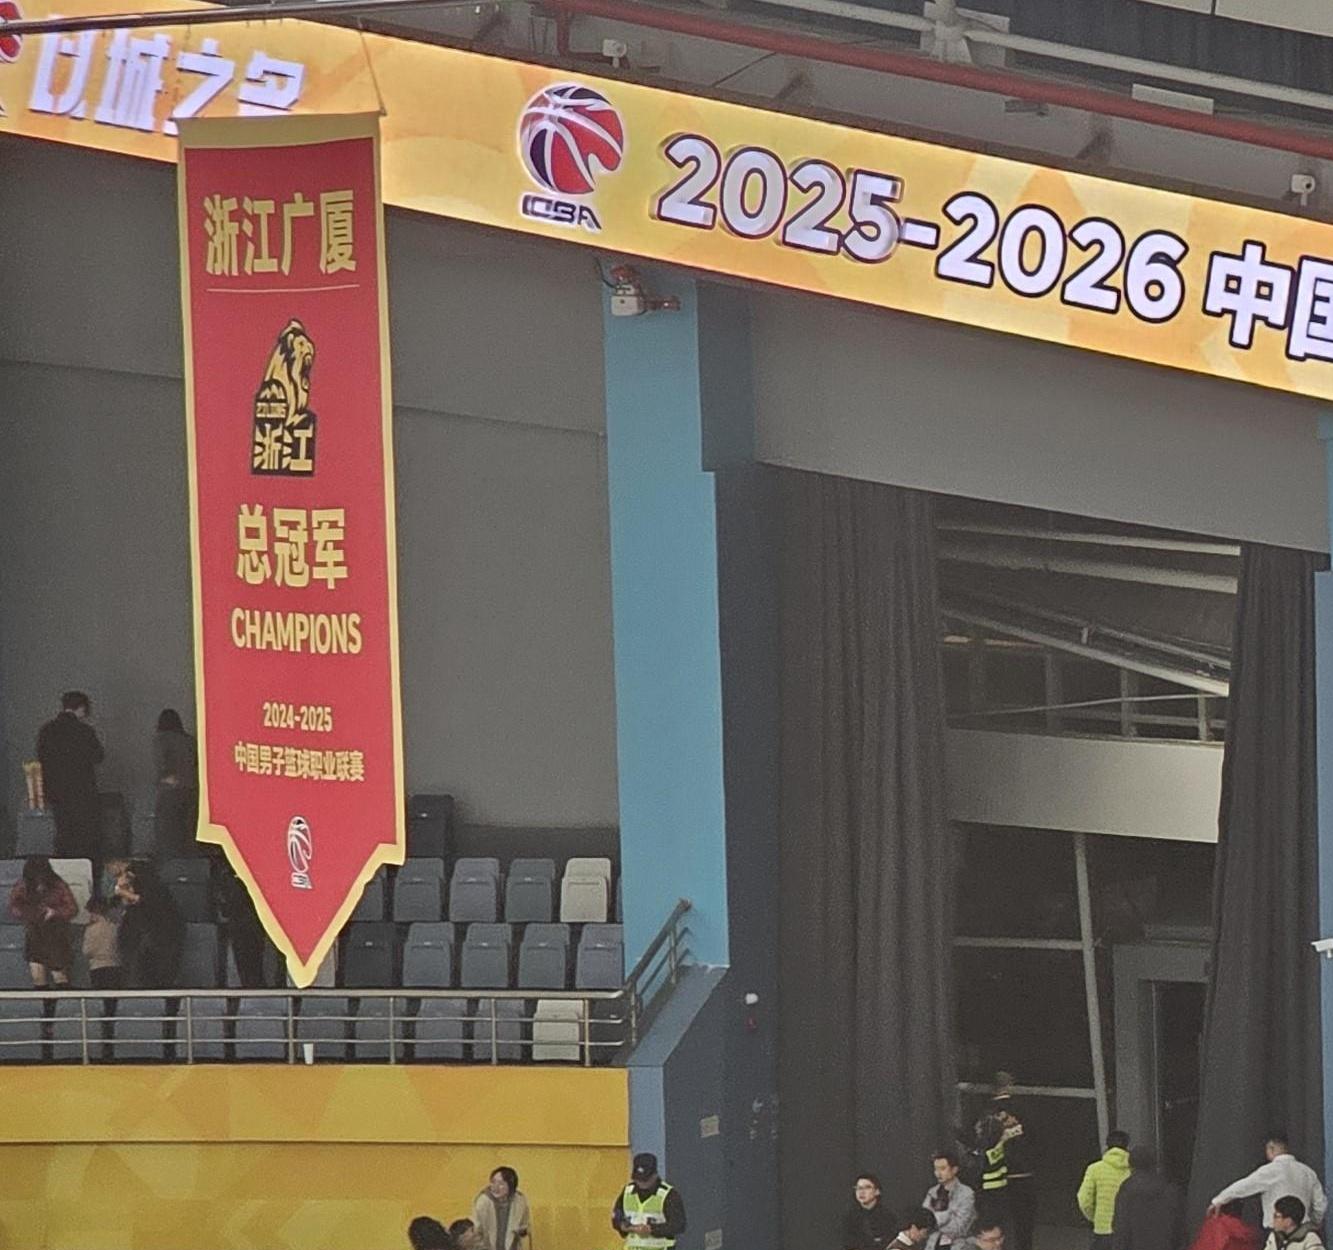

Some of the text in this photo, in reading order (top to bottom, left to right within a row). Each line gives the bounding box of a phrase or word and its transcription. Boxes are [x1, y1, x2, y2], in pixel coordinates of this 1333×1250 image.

[204, 190, 357, 276] 浙江广厦
[655, 132, 1190, 323] 2025-2026
[253, 422, 313, 471] 浙江
[236, 504, 349, 589] 总冠军
[231, 608, 362, 654] CHAMPIONS
[263, 702, 333, 732] 2024-2025
[234, 741, 365, 783] 中国男子篮球职业联赛
